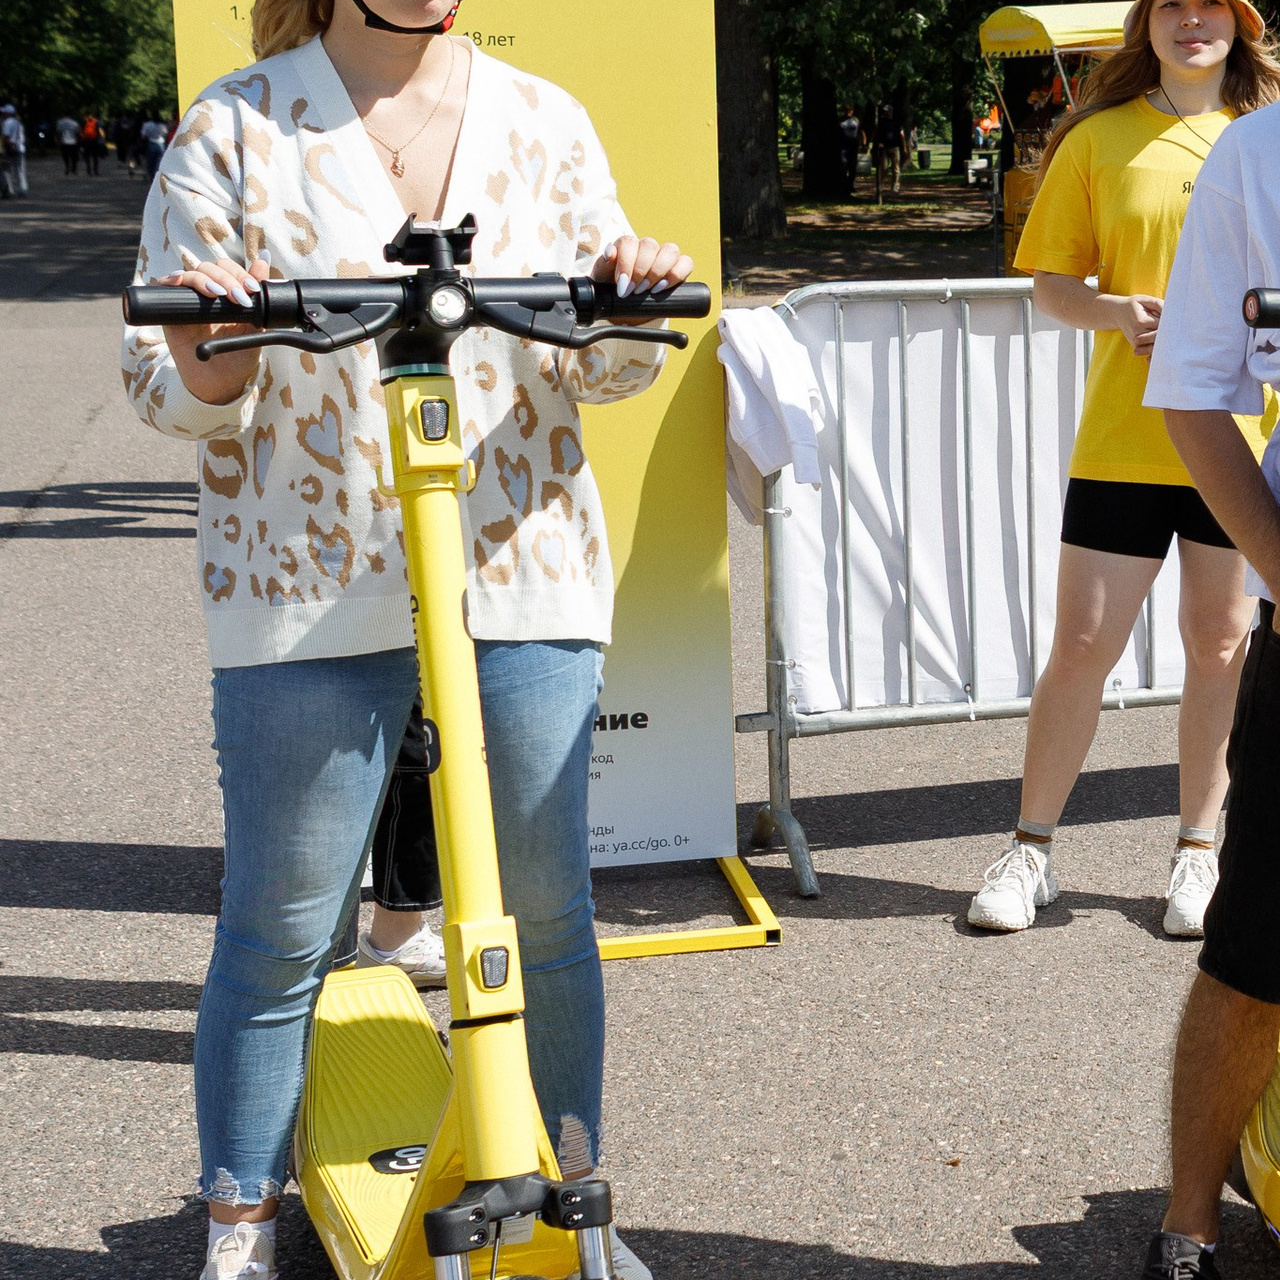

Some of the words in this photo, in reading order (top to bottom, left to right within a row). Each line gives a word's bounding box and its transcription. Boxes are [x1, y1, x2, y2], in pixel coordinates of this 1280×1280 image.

[486, 35, 516, 47] лет
[591, 754, 615, 765] код
[612, 836, 671, 854] ya.cc/go.
[674, 834, 691, 847] 0+
[389, 1147, 427, 1170] Go
